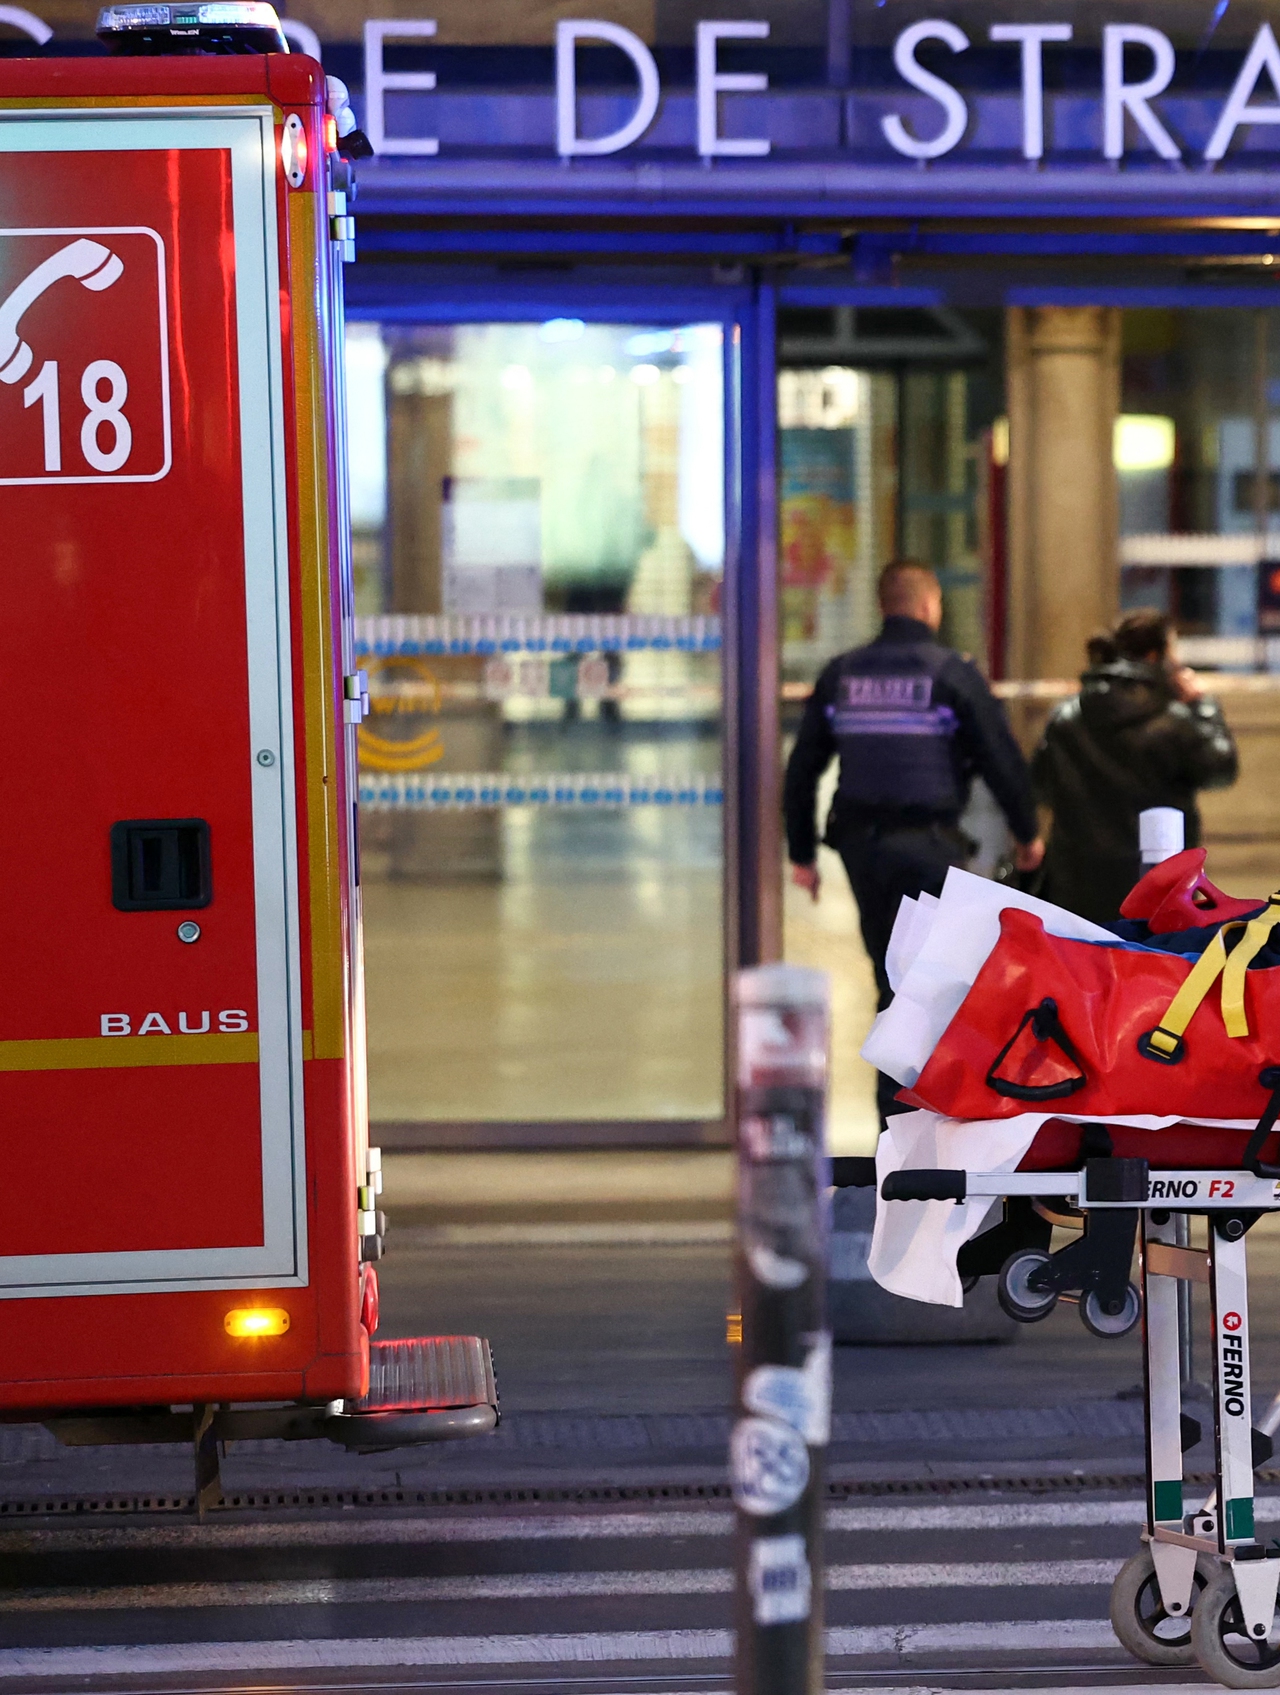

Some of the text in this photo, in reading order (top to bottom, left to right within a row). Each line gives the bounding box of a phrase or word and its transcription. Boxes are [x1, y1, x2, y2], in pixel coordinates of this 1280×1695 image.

[555, 19, 770, 156] DE
[23, 359, 132, 473] 18
[100, 1009, 250, 1037] BAUS
[1208, 1179, 1236, 1199] F2
[1222, 1333, 1245, 1417] FERNO
